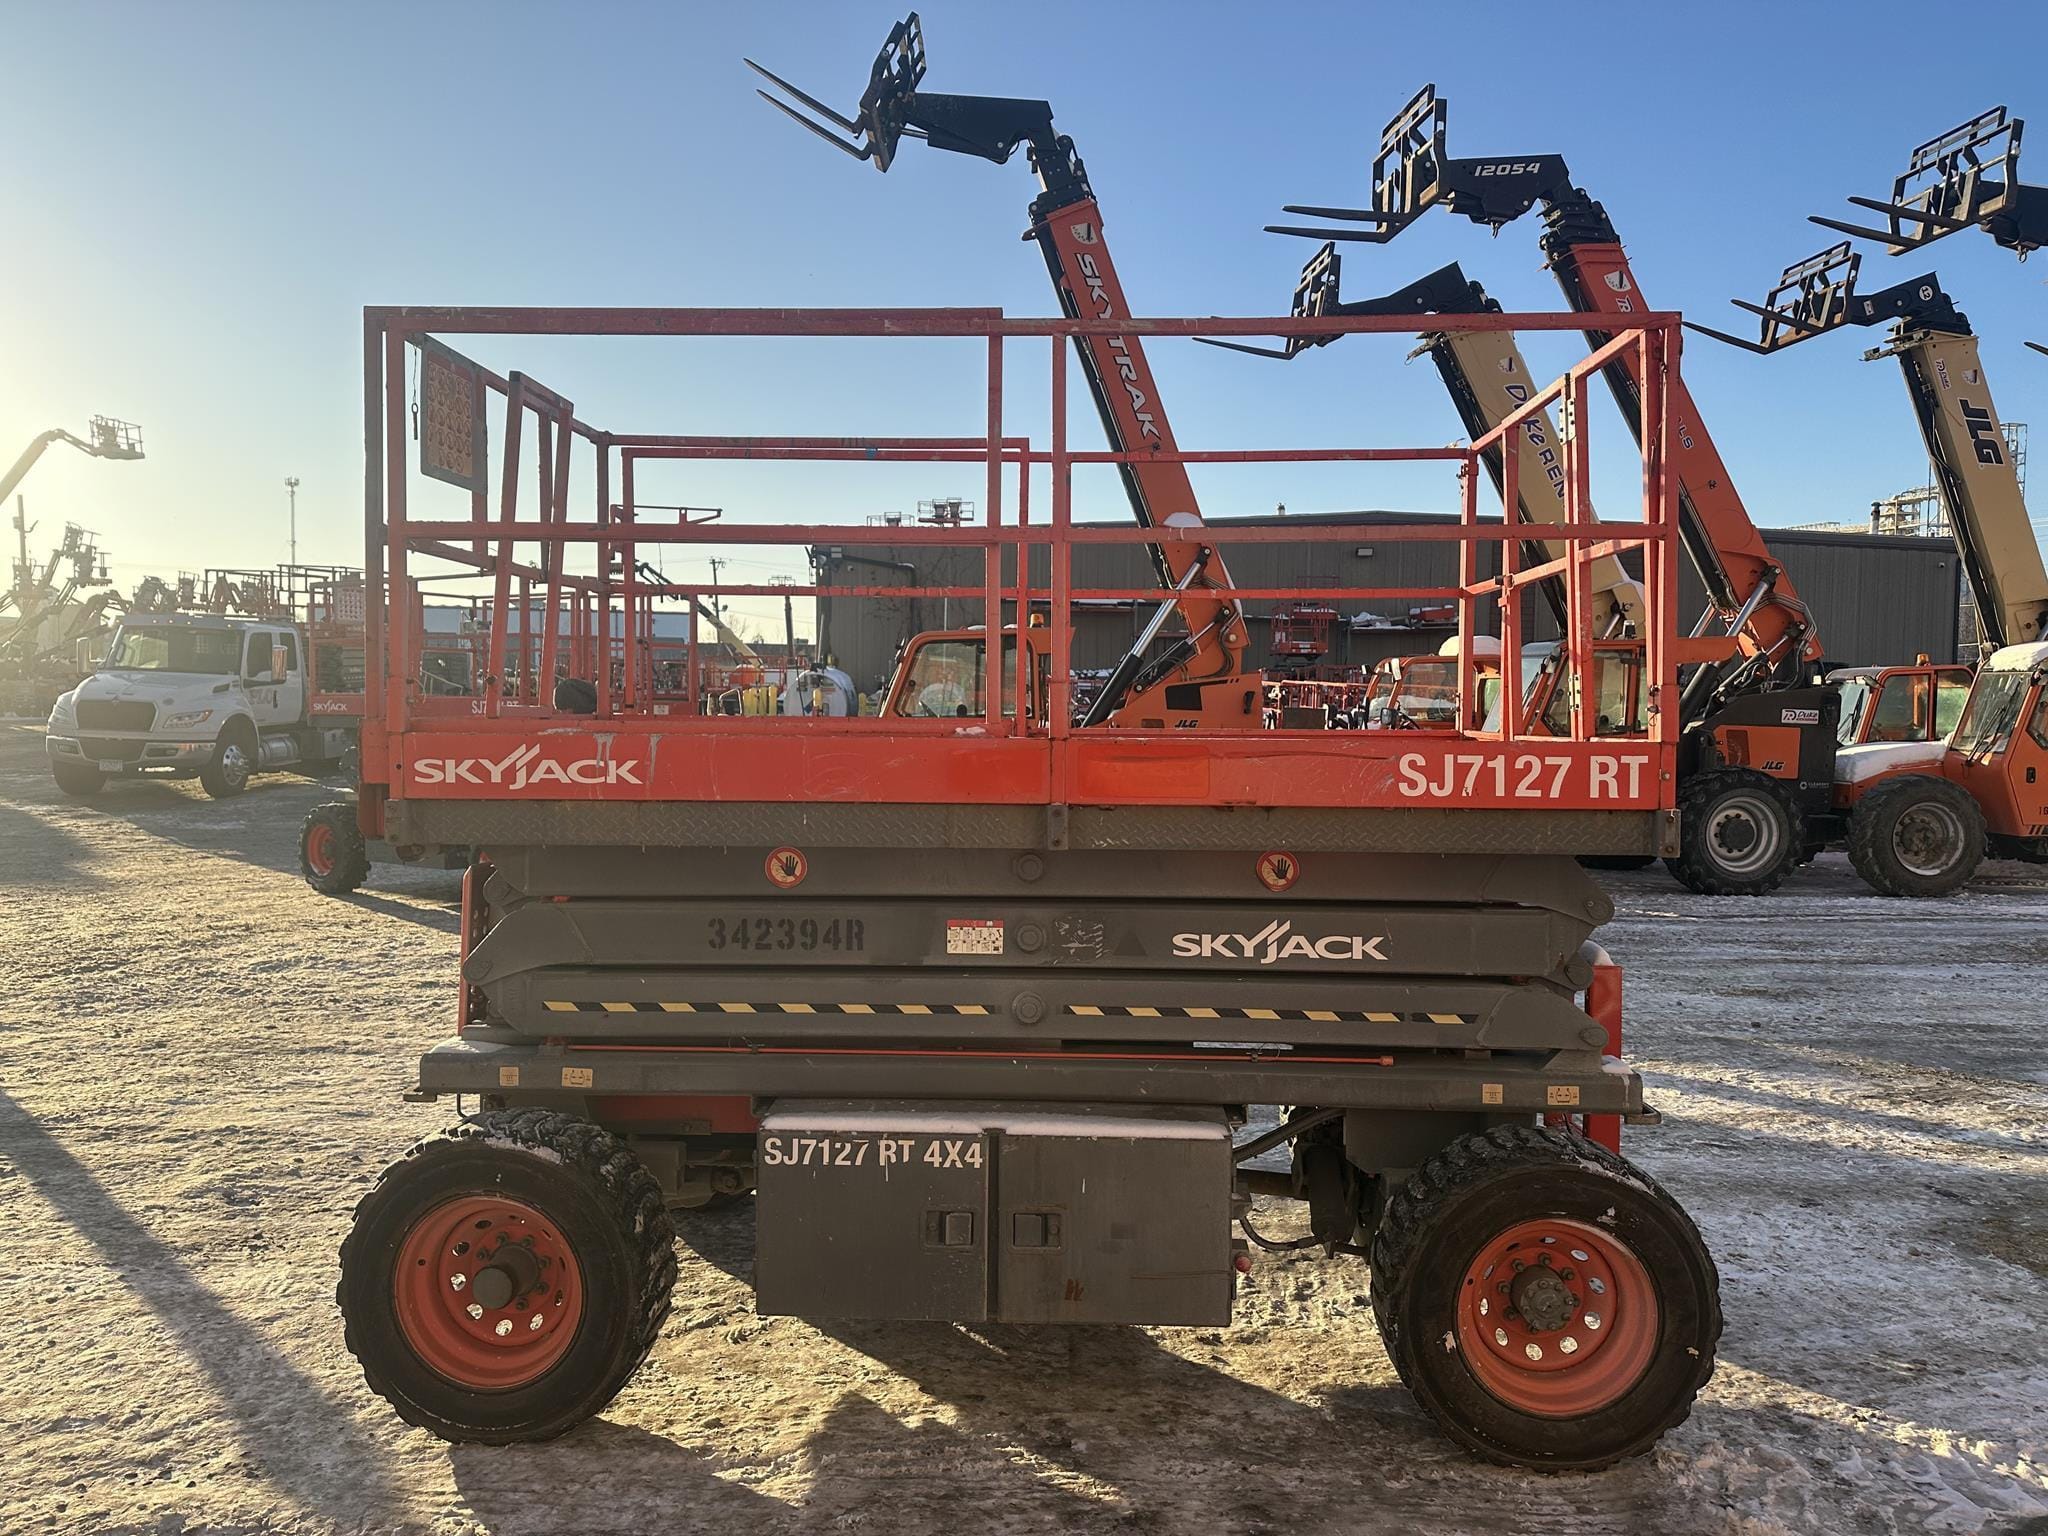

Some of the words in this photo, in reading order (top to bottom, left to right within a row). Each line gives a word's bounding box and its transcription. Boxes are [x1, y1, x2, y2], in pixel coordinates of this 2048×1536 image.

[1474, 163, 1541, 177] 12054
[1504, 384, 1546, 447] Dke
[1958, 398, 2004, 465] JLG
[313, 700, 347, 712] SKYJACK
[1174, 719, 1199, 729] JLG
[413, 743, 644, 790] SKYJACK
[1398, 753, 1573, 798] SJ7127
[1589, 755, 1649, 798] RT
[1760, 761, 1785, 770] JLG
[707, 917, 865, 951] 342394R
[1171, 919, 1389, 965] SKYJACK
[764, 1137, 870, 1166] SJ7127
[879, 1139, 915, 1167] RT
[923, 1140, 983, 1168] 4X4
